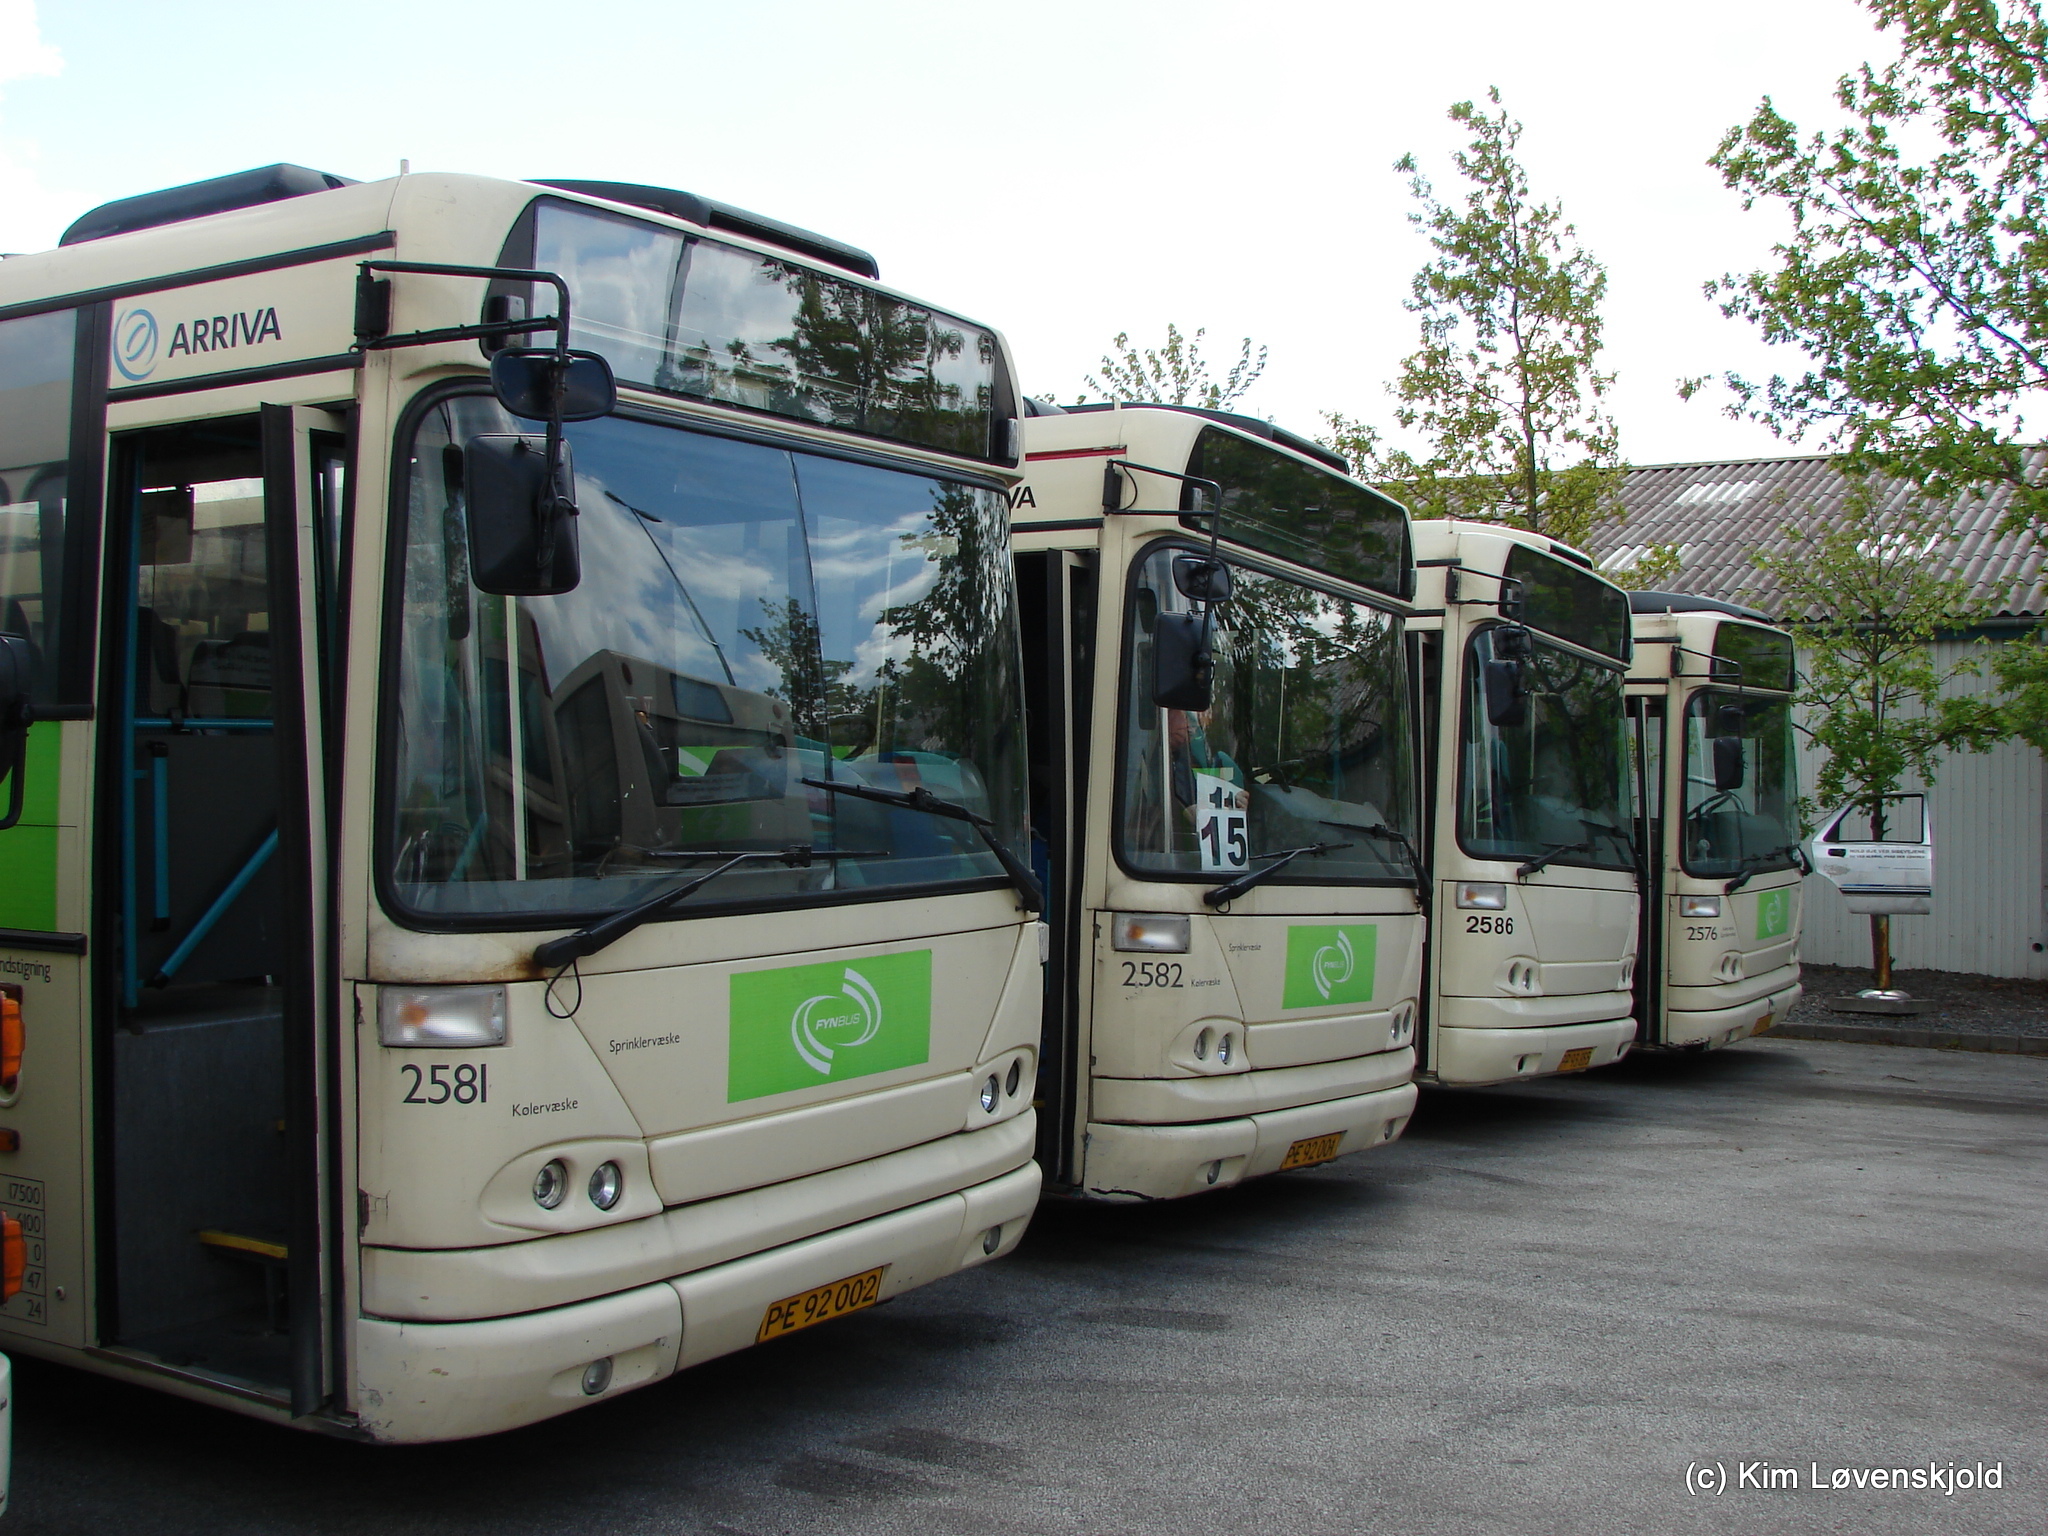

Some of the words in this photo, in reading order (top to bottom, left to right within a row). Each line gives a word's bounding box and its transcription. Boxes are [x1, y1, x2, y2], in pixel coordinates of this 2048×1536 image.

[168, 307, 282, 358] ARRIVA
[1201, 816, 1246, 866] 15
[1466, 915, 1514, 935] 2586
[1686, 926, 1718, 941] 2576
[1121, 961, 1184, 988] 2582
[815, 1013, 861, 1031] FYNBUS
[609, 1032, 681, 1054] Sprinklervæske
[401, 1063, 488, 1105] 2581
[511, 1098, 579, 1117] Kølervæske
[10, 1183, 40, 1204] 17500
[34, 1244, 41, 1261] 0
[27, 1272, 41, 1289] 47
[28, 1300, 41, 1318] 24
[765, 1300, 801, 1336] PE
